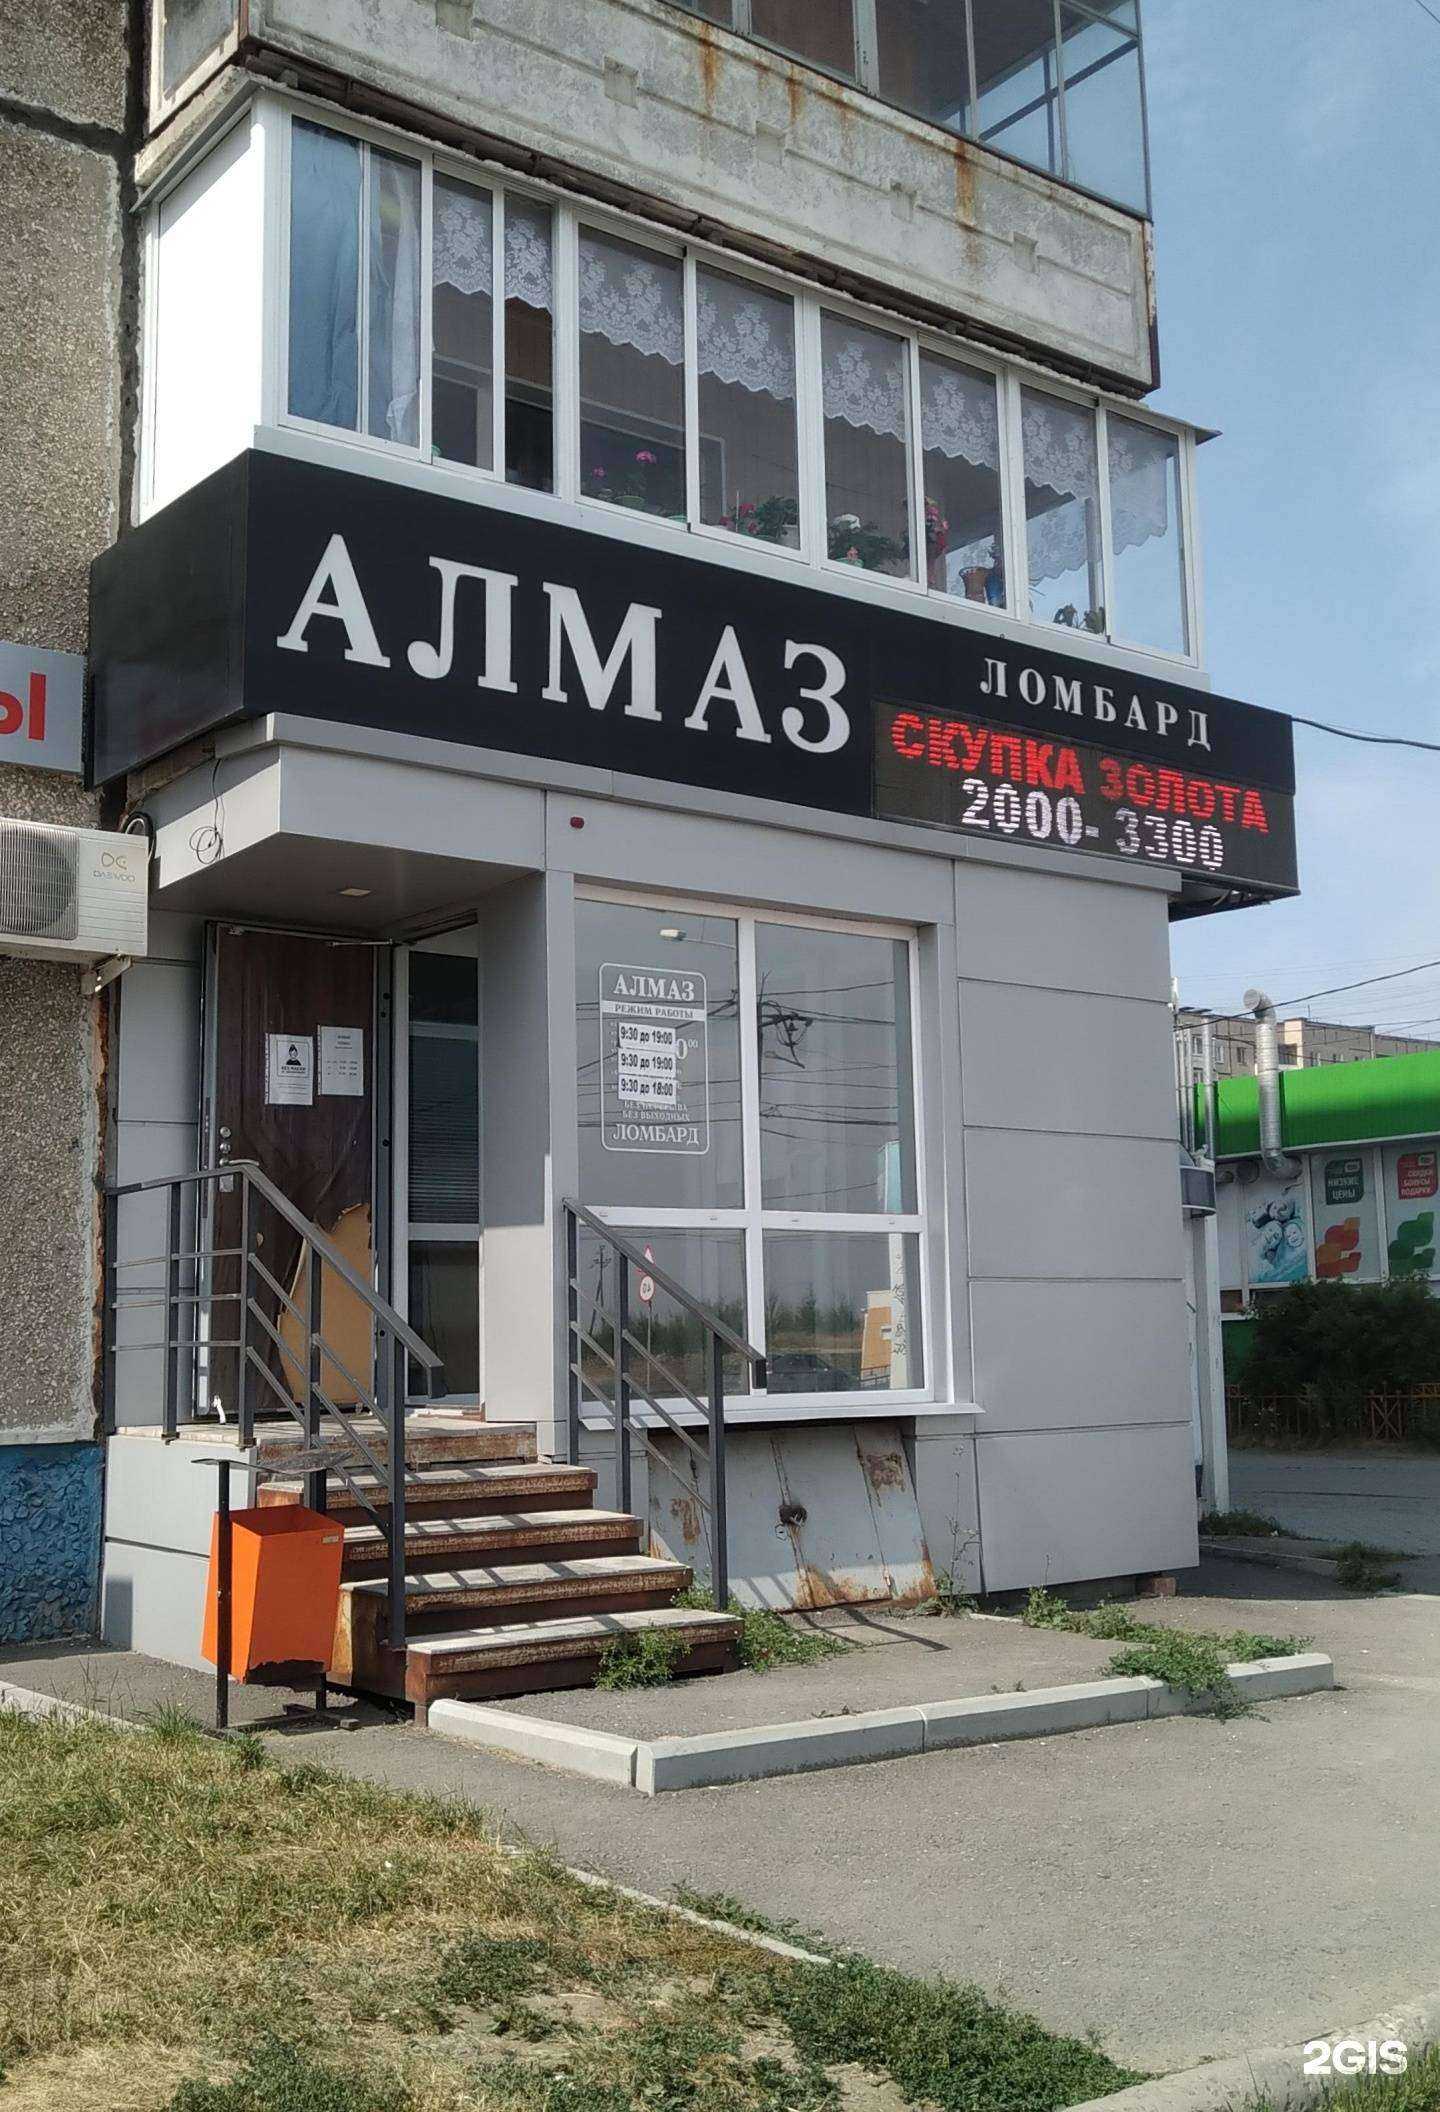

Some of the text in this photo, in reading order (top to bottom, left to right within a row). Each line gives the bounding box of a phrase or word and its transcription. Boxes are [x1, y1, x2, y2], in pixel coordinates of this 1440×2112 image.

[276, 533, 851, 754] АЛМАЗ
[979, 657, 1212, 752] ЛОМБАРД
[890, 711, 1270, 836] СКУПКА ЗОЛОТА
[1114, 807, 1224, 871] 3300
[613, 973, 695, 1001] АЛМАЗ
[614, 1003, 694, 1019] РЕЖИМ РАБОТЫ
[621, 1026, 638, 1041] 9:30
[640, 1032, 650, 1044] до
[652, 1030, 673, 1045] 19:00
[621, 1053, 673, 1071] 9:30 до 19:00
[621, 1078, 673, 1096] 9:30 до 18:00
[613, 1123, 700, 1146] ЛОМБАРД
